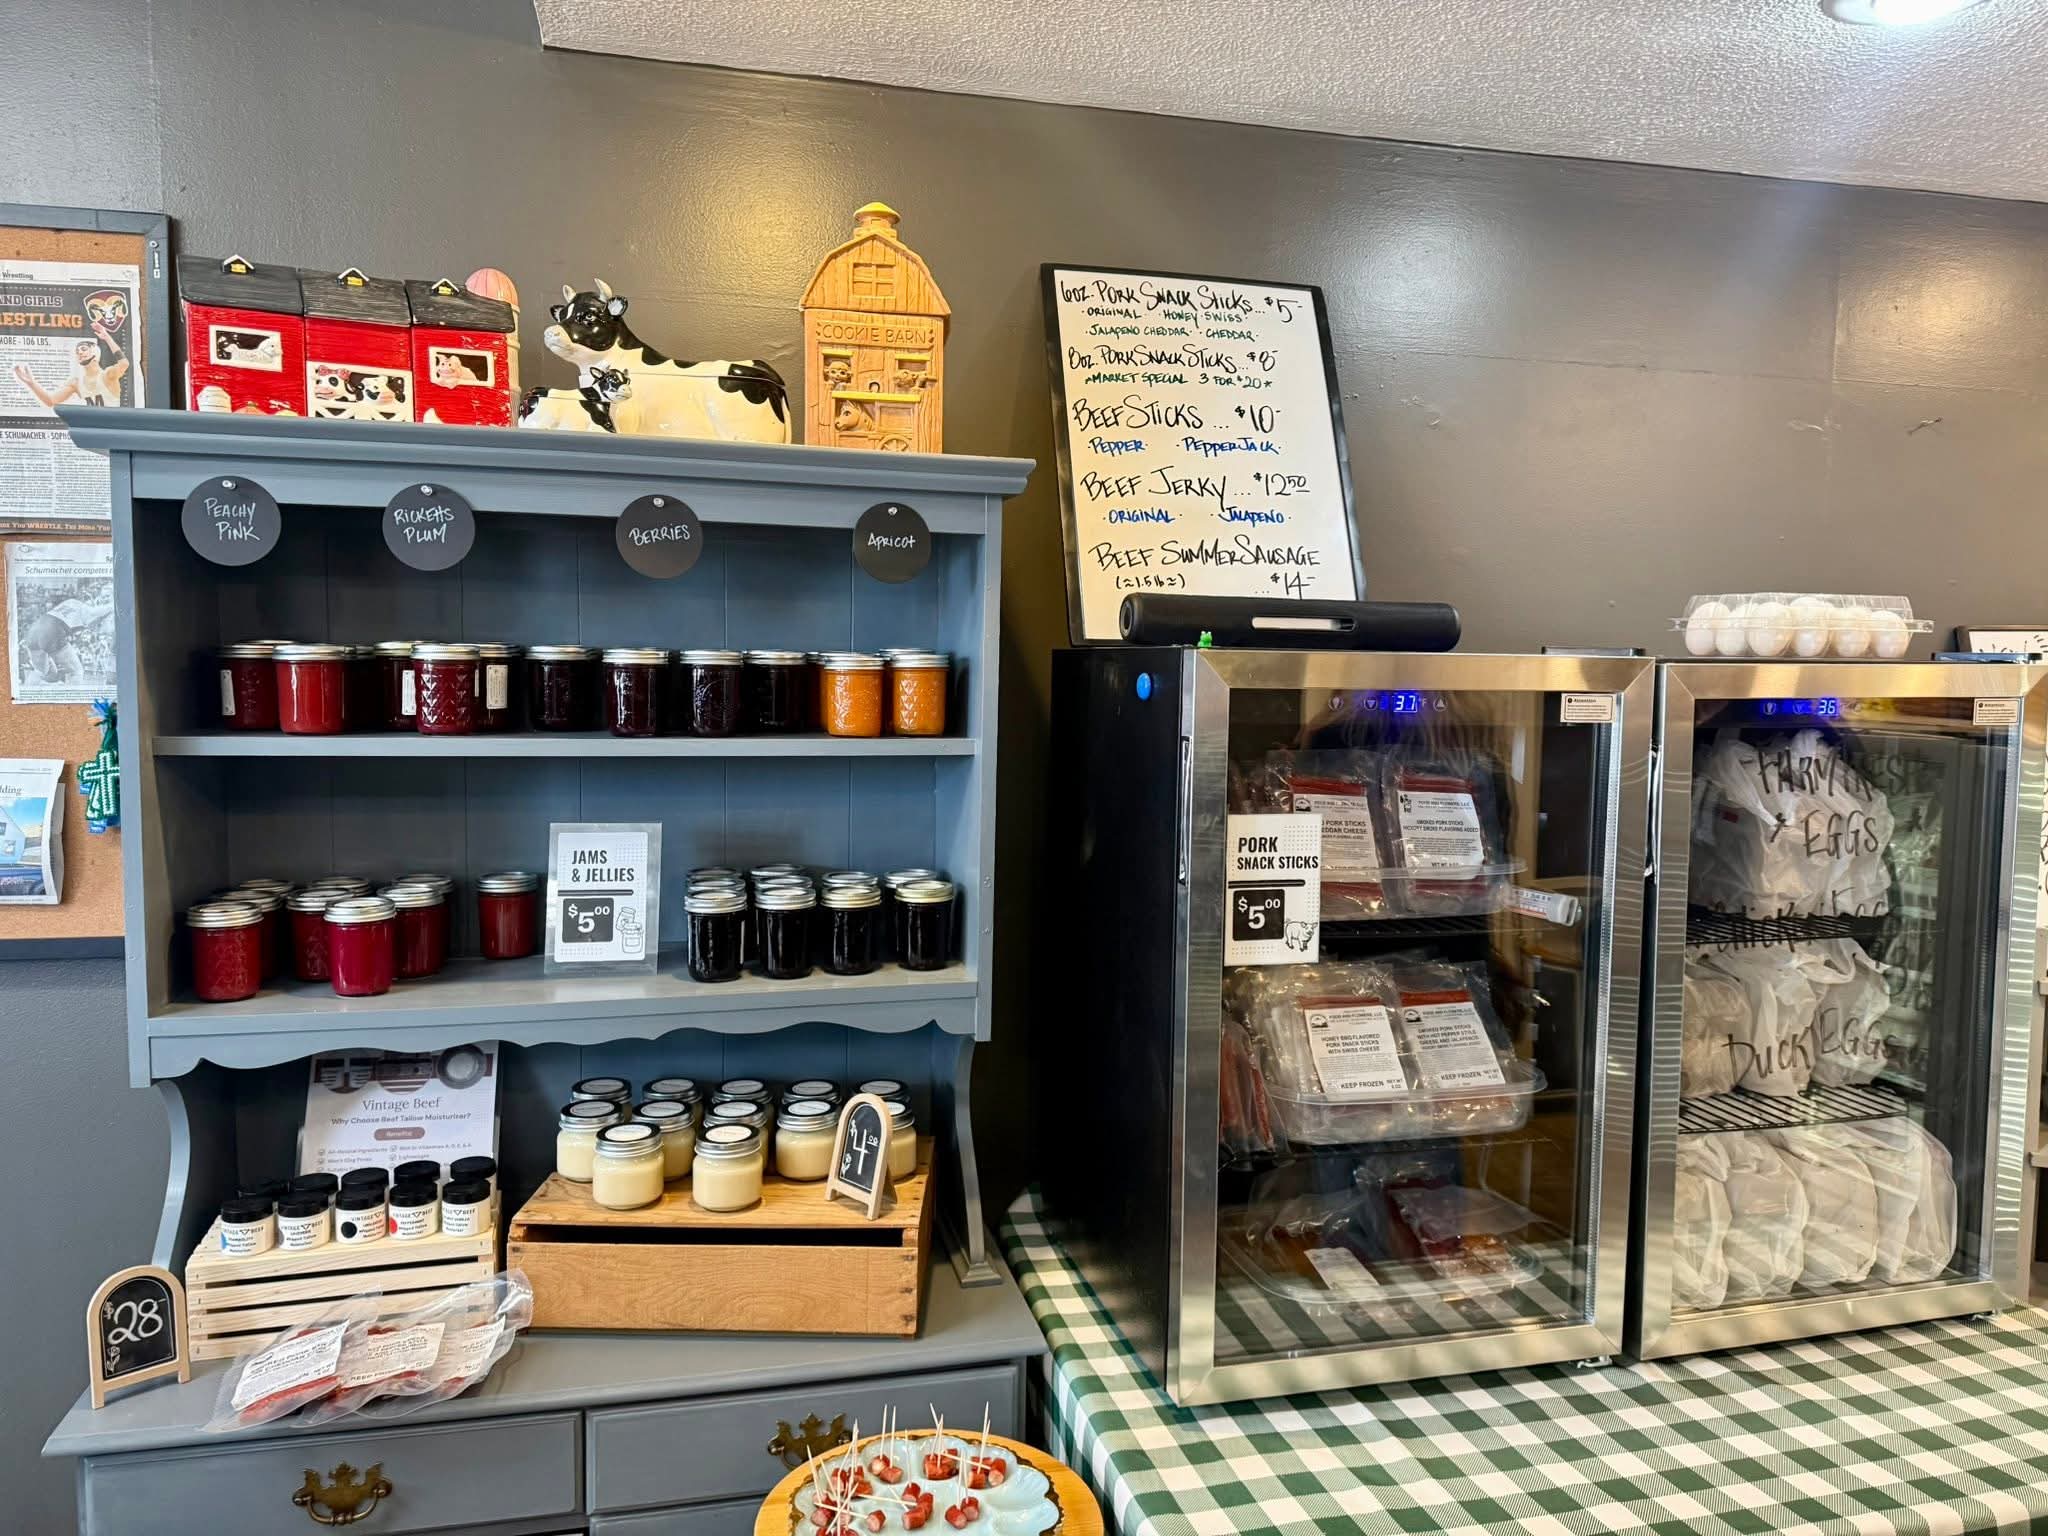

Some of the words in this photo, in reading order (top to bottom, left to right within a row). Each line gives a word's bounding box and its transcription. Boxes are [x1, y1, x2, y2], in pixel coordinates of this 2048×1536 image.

[23, 295, 63, 308] GIRLS
[1091, 279, 1141, 305] PORK
[1140, 280, 1199, 312] SNACK
[0, 312, 84, 329] ESTLING
[1086, 305, 1143, 320] ORIGINAL
[1162, 308, 1200, 329] HONEY
[1204, 310, 1243, 323] SWISS
[22, 337, 35, 346] 106
[822, 323, 880, 343] COOKIE
[885, 329, 928, 345] BARN
[1143, 325, 1191, 337] CHEDDAR
[1205, 327, 1256, 343] CHEDDAR
[1093, 344, 1139, 367] PORK
[1133, 344, 1187, 368] SNACK
[1141, 371, 1189, 388] SPECIAL
[1198, 372, 1210, 385] 3
[1212, 374, 1237, 386] FOR
[1071, 397, 1125, 432] BEEF
[1122, 393, 1205, 430] STICKS
[4, 431, 46, 440] SCHUMACHER
[1088, 436, 1146, 457] PEPPER
[1079, 470, 1143, 502] BEEF
[1148, 464, 1227, 513] JERKY
[203, 497, 257, 526] PEACHY
[1108, 507, 1176, 525] ORIGINAL
[215, 521, 262, 542] PINK
[402, 522, 448, 544] PLUM
[628, 523, 691, 547] BERRIES
[1087, 541, 1155, 572] BEEF
[1160, 537, 1242, 567] SUMMER
[1233, 533, 1321, 567] SAUSAGE
[25, 565, 72, 575] Schumacher
[1394, 694, 1418, 712] 37
[1818, 699, 1837, 715] 36
[1757, 748, 1838, 798] FARM
[1321, 827, 1343, 835] EDDAR
[1801, 808, 1879, 861] EGGS
[1237, 836, 1279, 853] PORK
[571, 850, 608, 865] JAMS
[1236, 856, 1276, 871] SNACK
[1278, 855, 1320, 869] STICKS
[571, 867, 581, 883] &
[585, 867, 635, 883] JELLIES
[1721, 1024, 1815, 1086] DUCK
[1358, 1080, 1385, 1088] FROZEN
[1440, 1073, 1457, 1081] KEEP
[1457, 1071, 1482, 1079] FROZEN
[362, 1098, 410, 1113] Vintage
[413, 1096, 442, 1109] Beef
[331, 1118, 349, 1126] Why
[350, 1116, 380, 1125] Choose
[380, 1115, 399, 1123] Beef
[399, 1114, 424, 1122] Tallow
[424, 1112, 472, 1121] Moisturizer?
